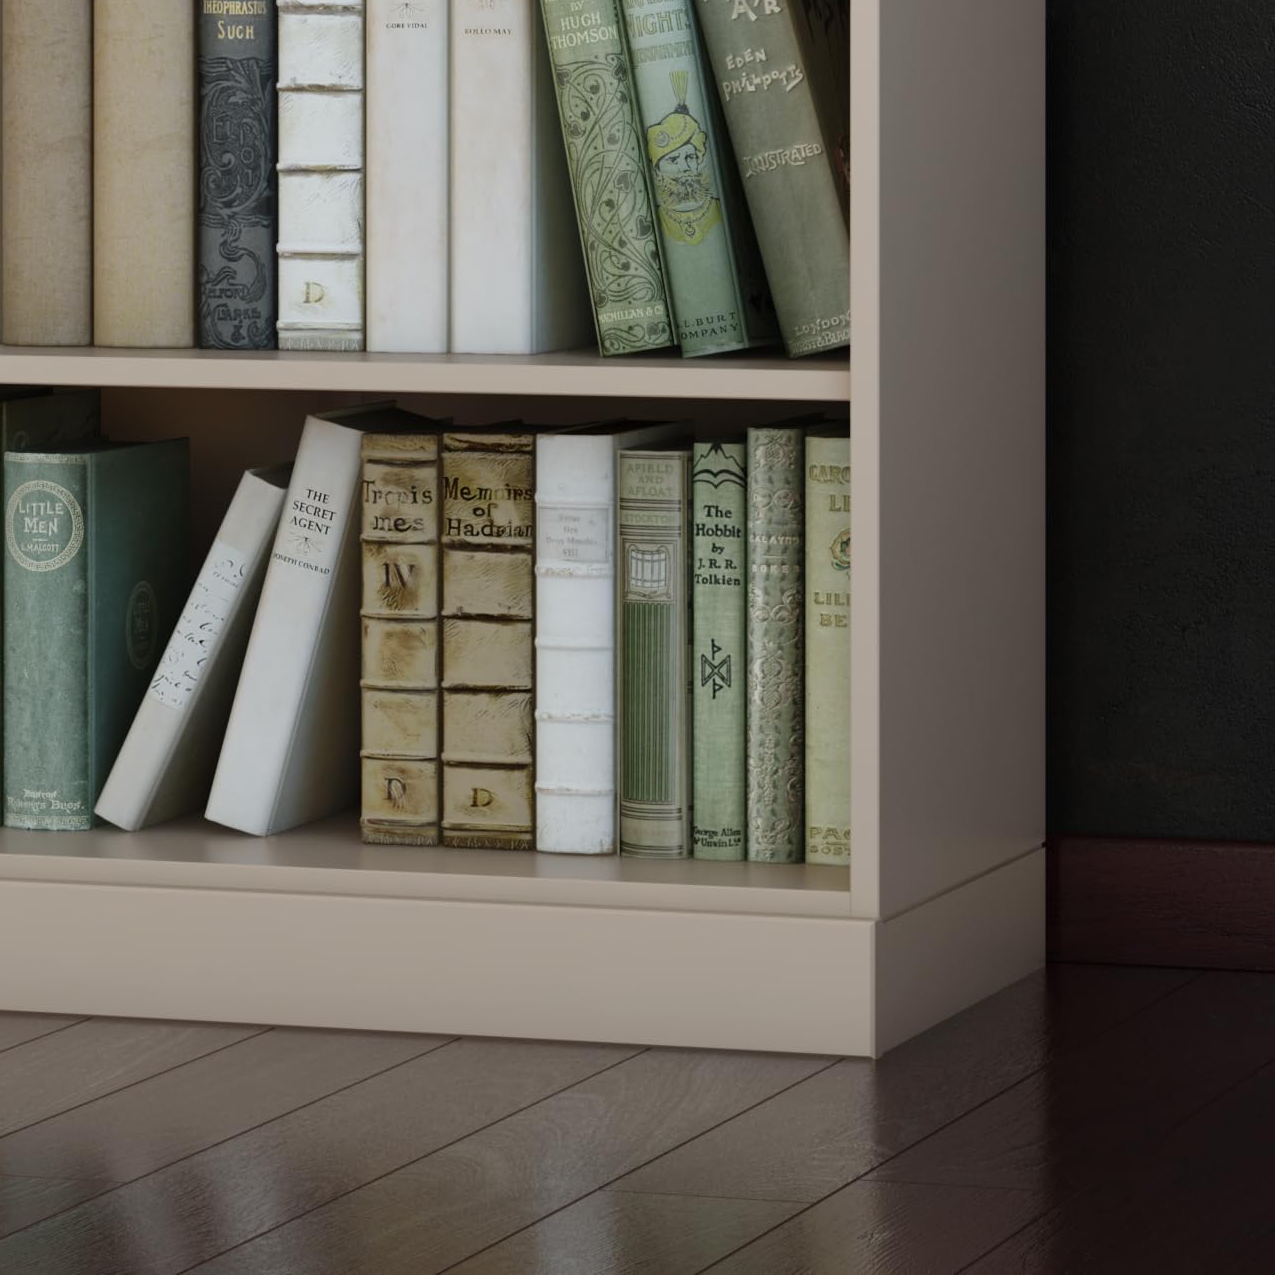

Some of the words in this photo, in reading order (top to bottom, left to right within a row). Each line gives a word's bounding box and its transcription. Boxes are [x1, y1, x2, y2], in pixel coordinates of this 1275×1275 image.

[570, 0, 585, 12] BY
[560, 12, 602, 32] HUGH
[217, 21, 255, 39] SUCH
[550, 27, 618, 51] THOMSON
[726, 48, 767, 70] EDEN
[302, 281, 325, 304] D
[627, 463, 674, 474] AFIELD
[637, 475, 663, 485] AND
[305, 489, 330, 504] THE
[628, 485, 671, 497] AFLOAT
[19, 501, 64, 516] LITTLE
[292, 501, 337, 521] SECRET
[473, 502, 498, 517] of
[703, 505, 733, 518] The
[23, 517, 58, 536] MEN
[290, 516, 332, 535] AGENT
[695, 524, 741, 538] Hobbit
[711, 543, 725, 554] by
[697, 559, 706, 569] J.
[708, 559, 721, 569] R.
[725, 559, 737, 570] R.
[695, 574, 741, 586] Tolkien
[470, 788, 493, 807] D
